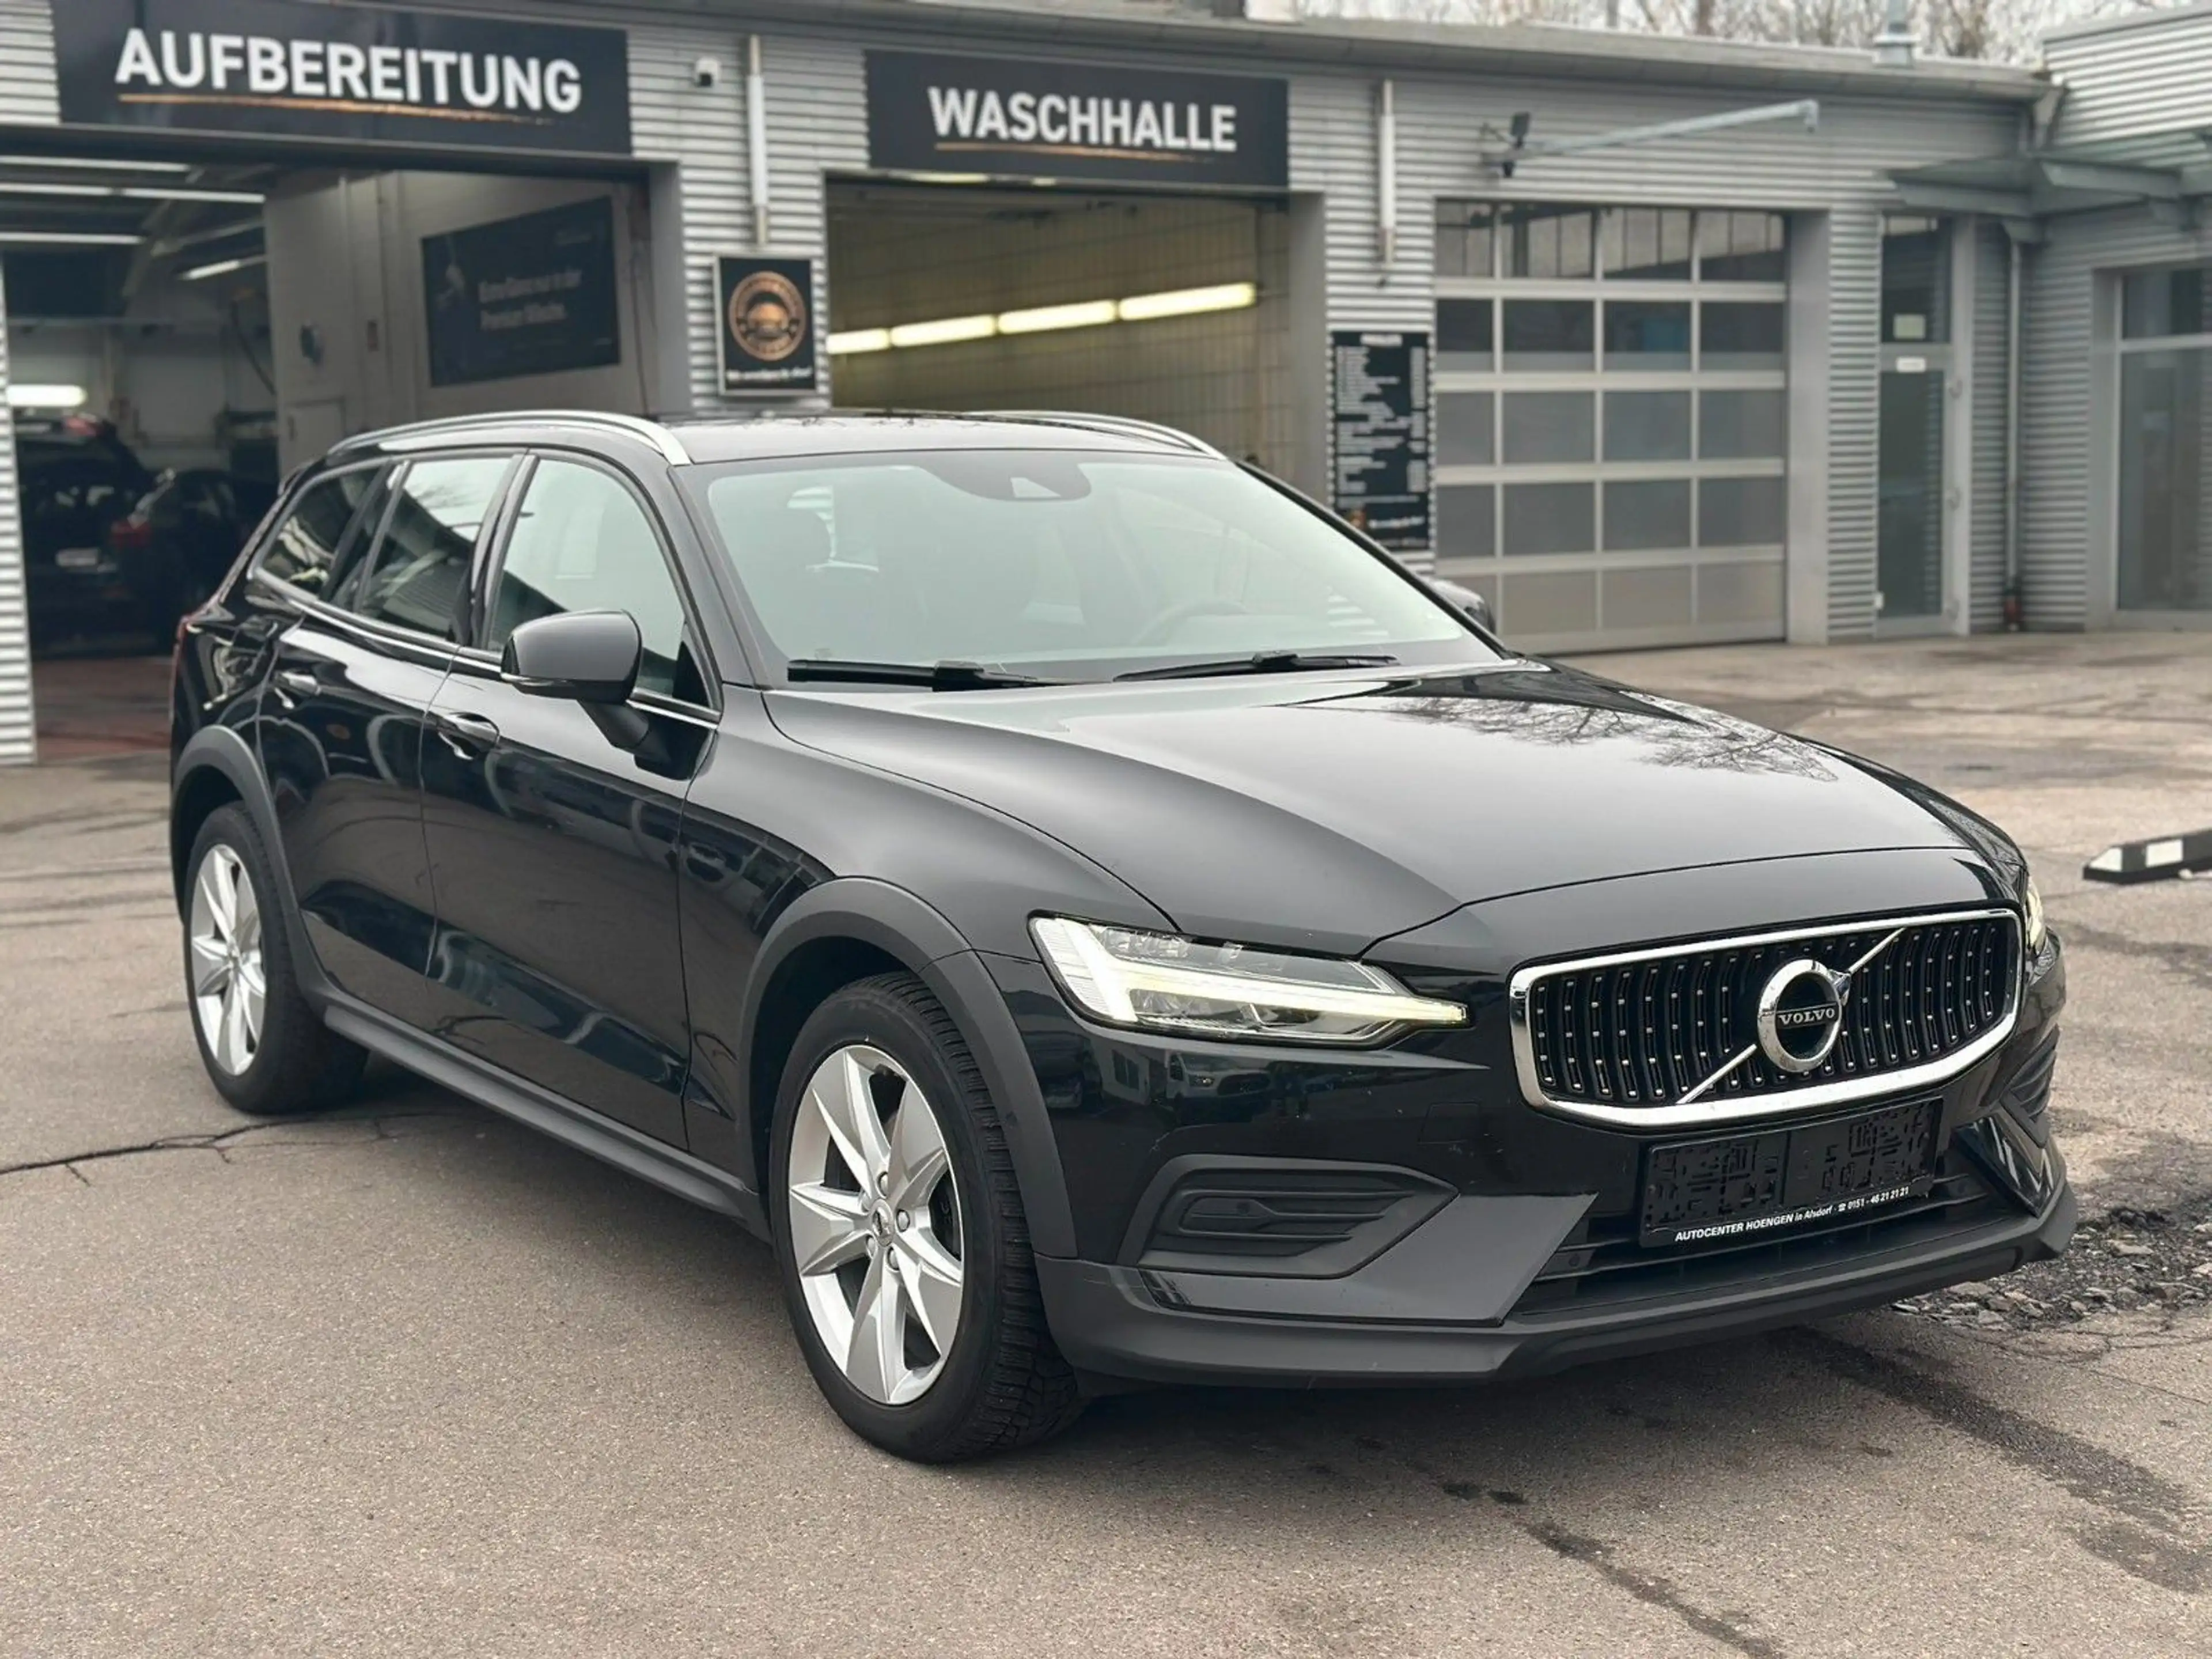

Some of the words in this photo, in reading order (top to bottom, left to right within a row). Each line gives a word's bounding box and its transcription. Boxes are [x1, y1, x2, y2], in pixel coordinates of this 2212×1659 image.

[115, 28, 581, 112] AUFBEREITUNG
[927, 86, 1237, 151] WASCHHALLE
[1777, 1008, 1835, 1025] VOLVO
[1675, 1222, 1744, 1241] AUTOCENTER
[1745, 1214, 1794, 1230] HOENGEN
